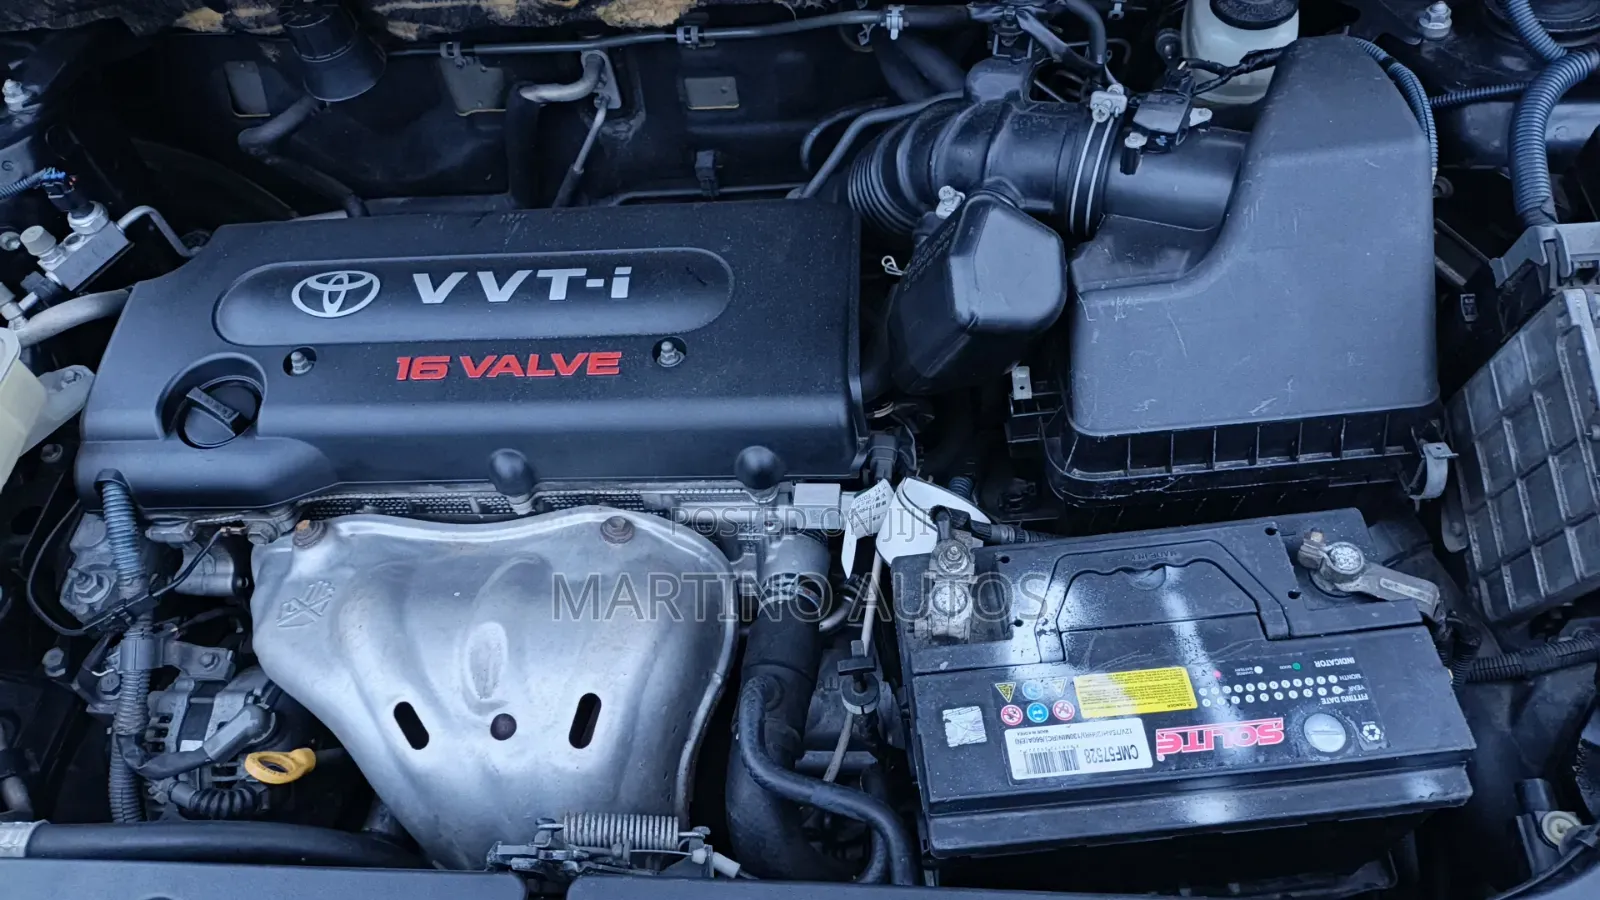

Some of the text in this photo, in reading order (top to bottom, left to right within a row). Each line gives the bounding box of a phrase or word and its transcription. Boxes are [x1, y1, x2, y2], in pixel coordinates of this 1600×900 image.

[412, 266, 632, 304] VVT-i
[396, 351, 622, 381] 16 VALVE
[1313, 657, 1355, 668] INDICATOR
[1339, 673, 1362, 681] MONTH
[1348, 684, 1366, 692] YEAR
[1320, 693, 1369, 705] FITTING DATE
[1156, 720, 1285, 756] SOLITE
[1083, 744, 1139, 764] CMF57528
